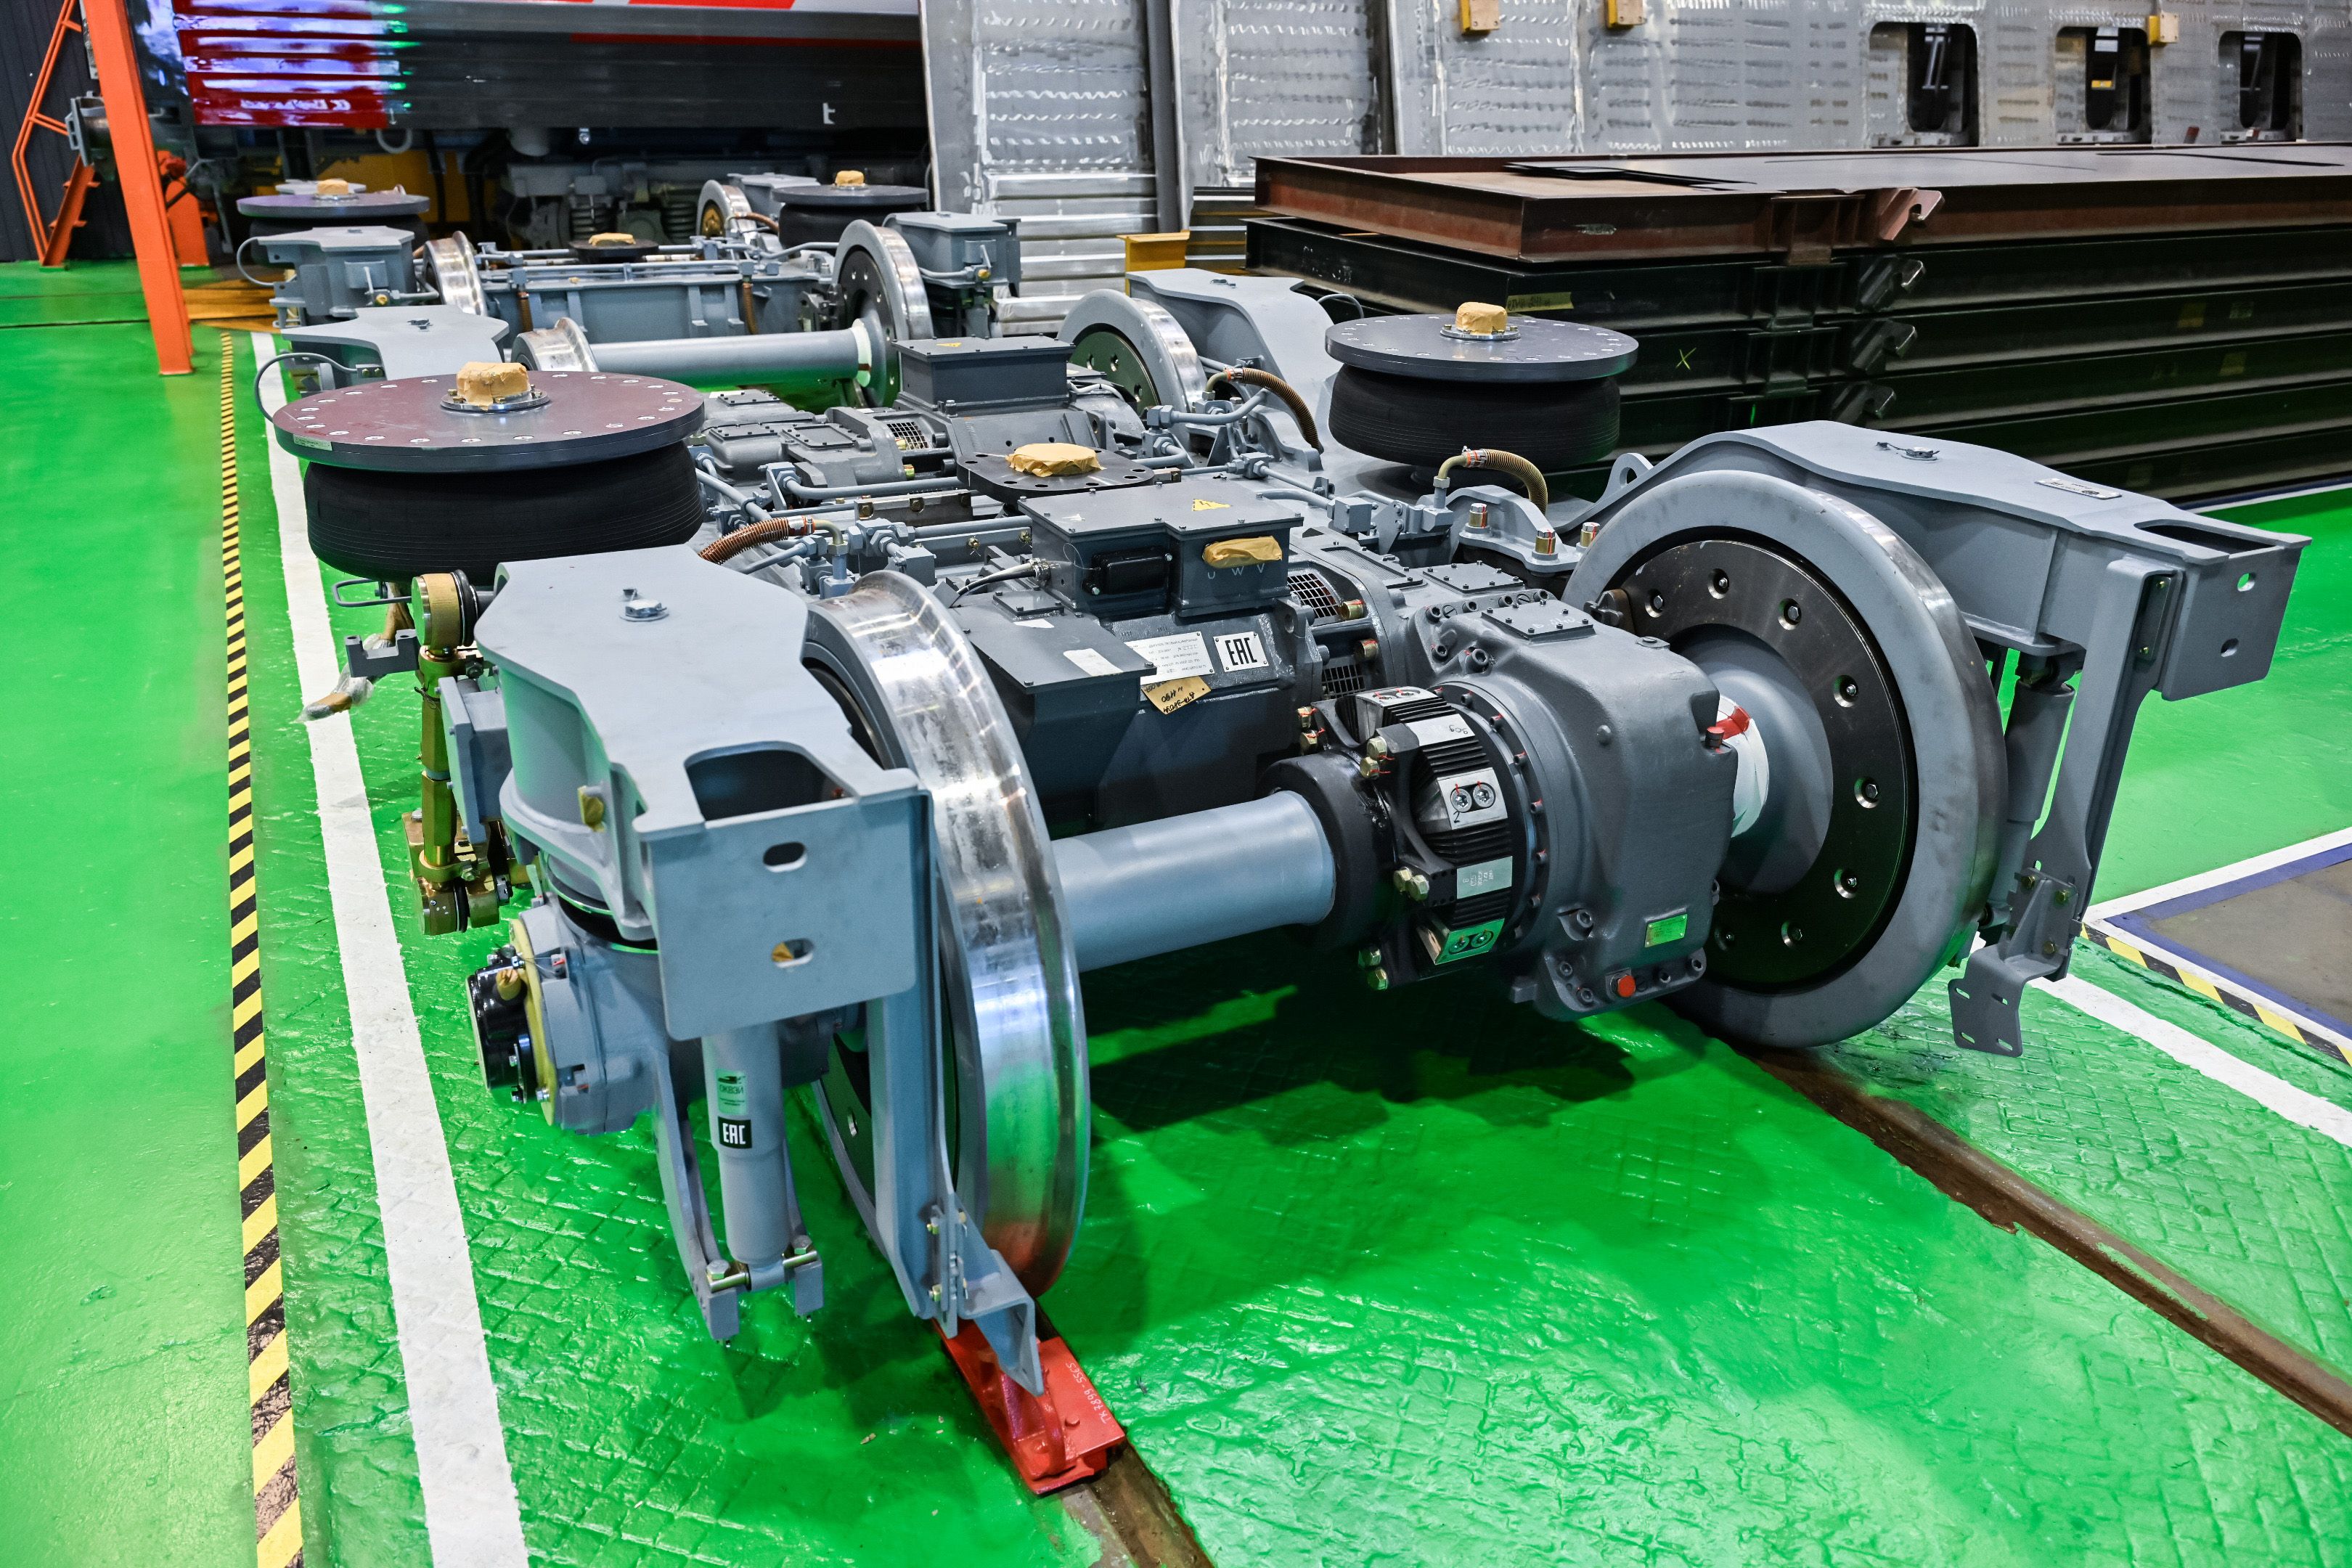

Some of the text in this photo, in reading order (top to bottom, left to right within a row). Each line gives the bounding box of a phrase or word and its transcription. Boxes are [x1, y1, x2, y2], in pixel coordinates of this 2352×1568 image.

[1231, 565, 1244, 576] W
[1257, 563, 1265, 573] V
[1225, 637, 1258, 666] EAC
[722, 1122, 746, 1145] EAC
